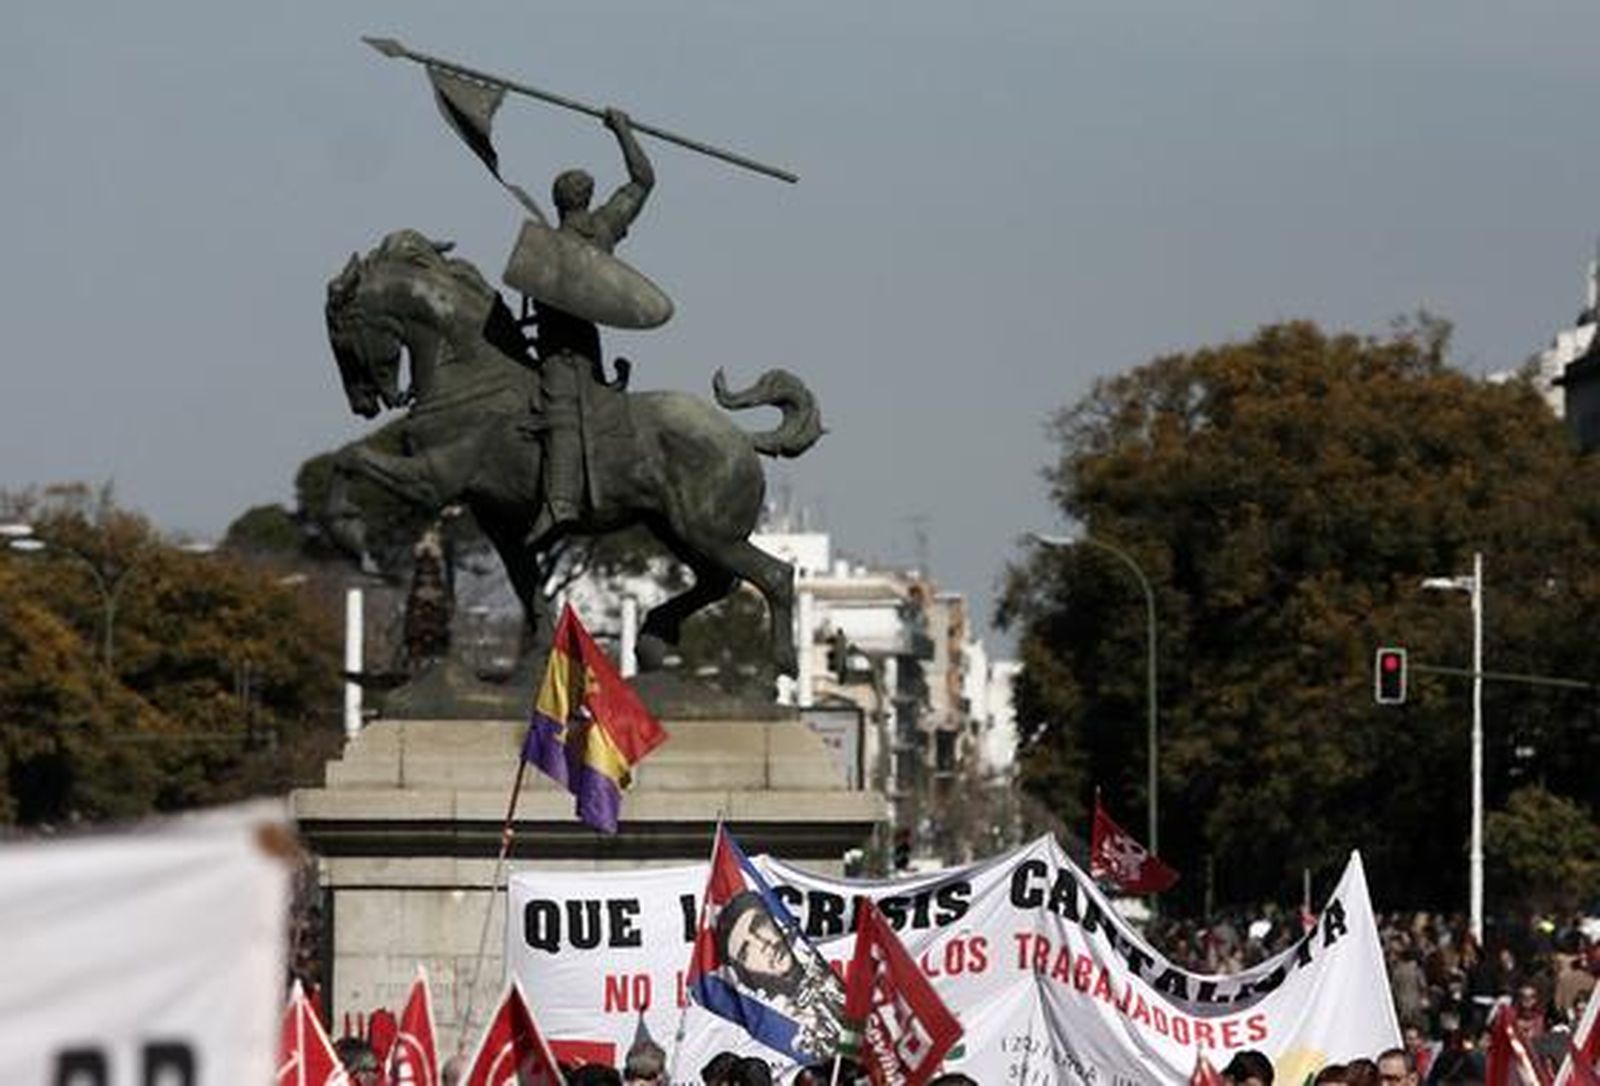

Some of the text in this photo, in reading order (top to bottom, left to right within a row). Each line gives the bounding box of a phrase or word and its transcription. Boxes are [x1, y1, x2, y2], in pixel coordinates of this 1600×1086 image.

[524, 898, 642, 954] QUE
[604, 973, 652, 1012] NO
[1014, 933, 1268, 1050] TRABAJADORES
